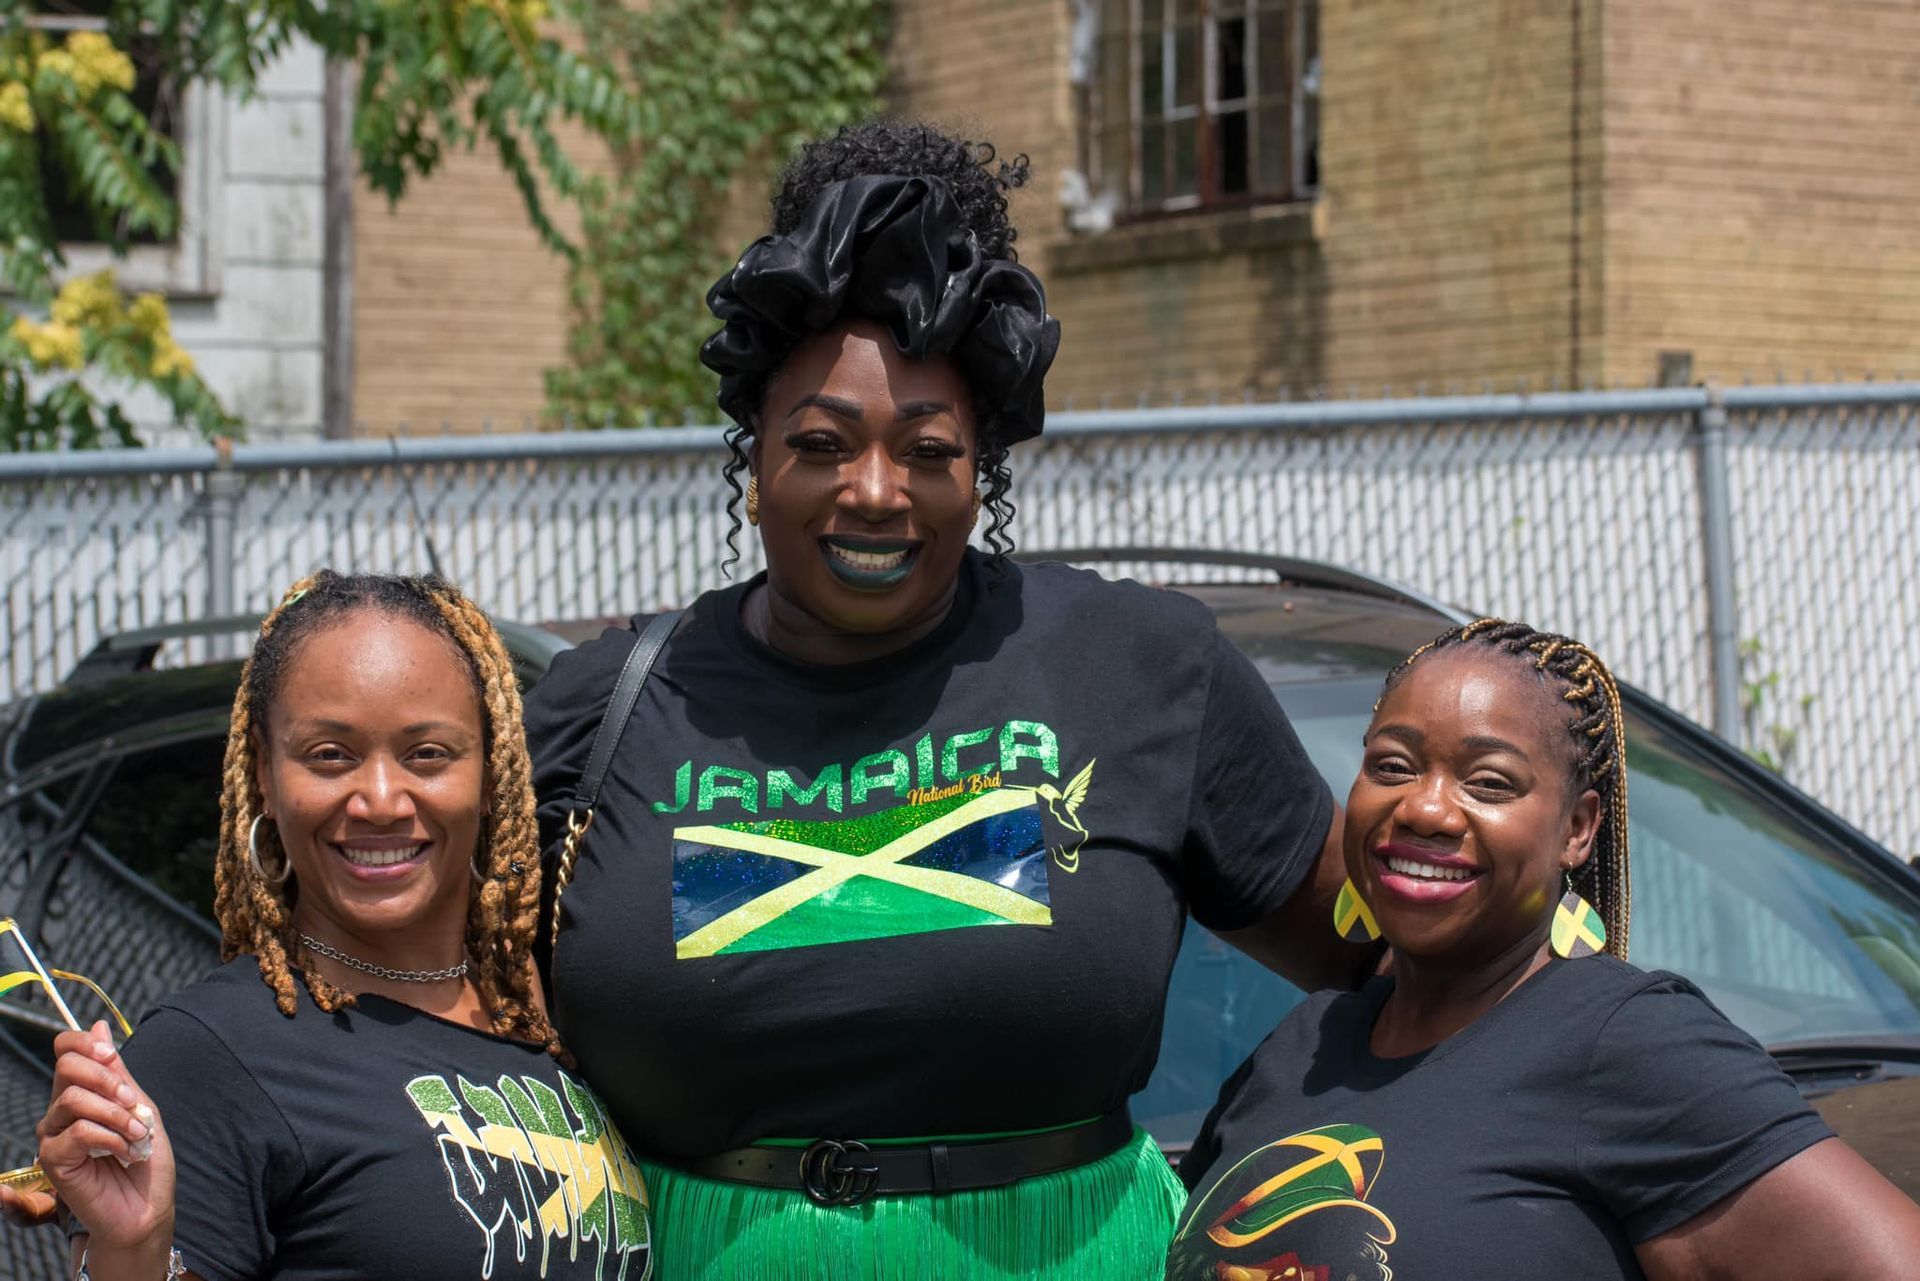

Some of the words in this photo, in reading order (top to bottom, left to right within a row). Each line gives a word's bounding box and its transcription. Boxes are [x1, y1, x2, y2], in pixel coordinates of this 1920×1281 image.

[650, 719, 1060, 814] JAMAICA
[906, 778, 965, 807] National
[967, 770, 1002, 795] Bird
